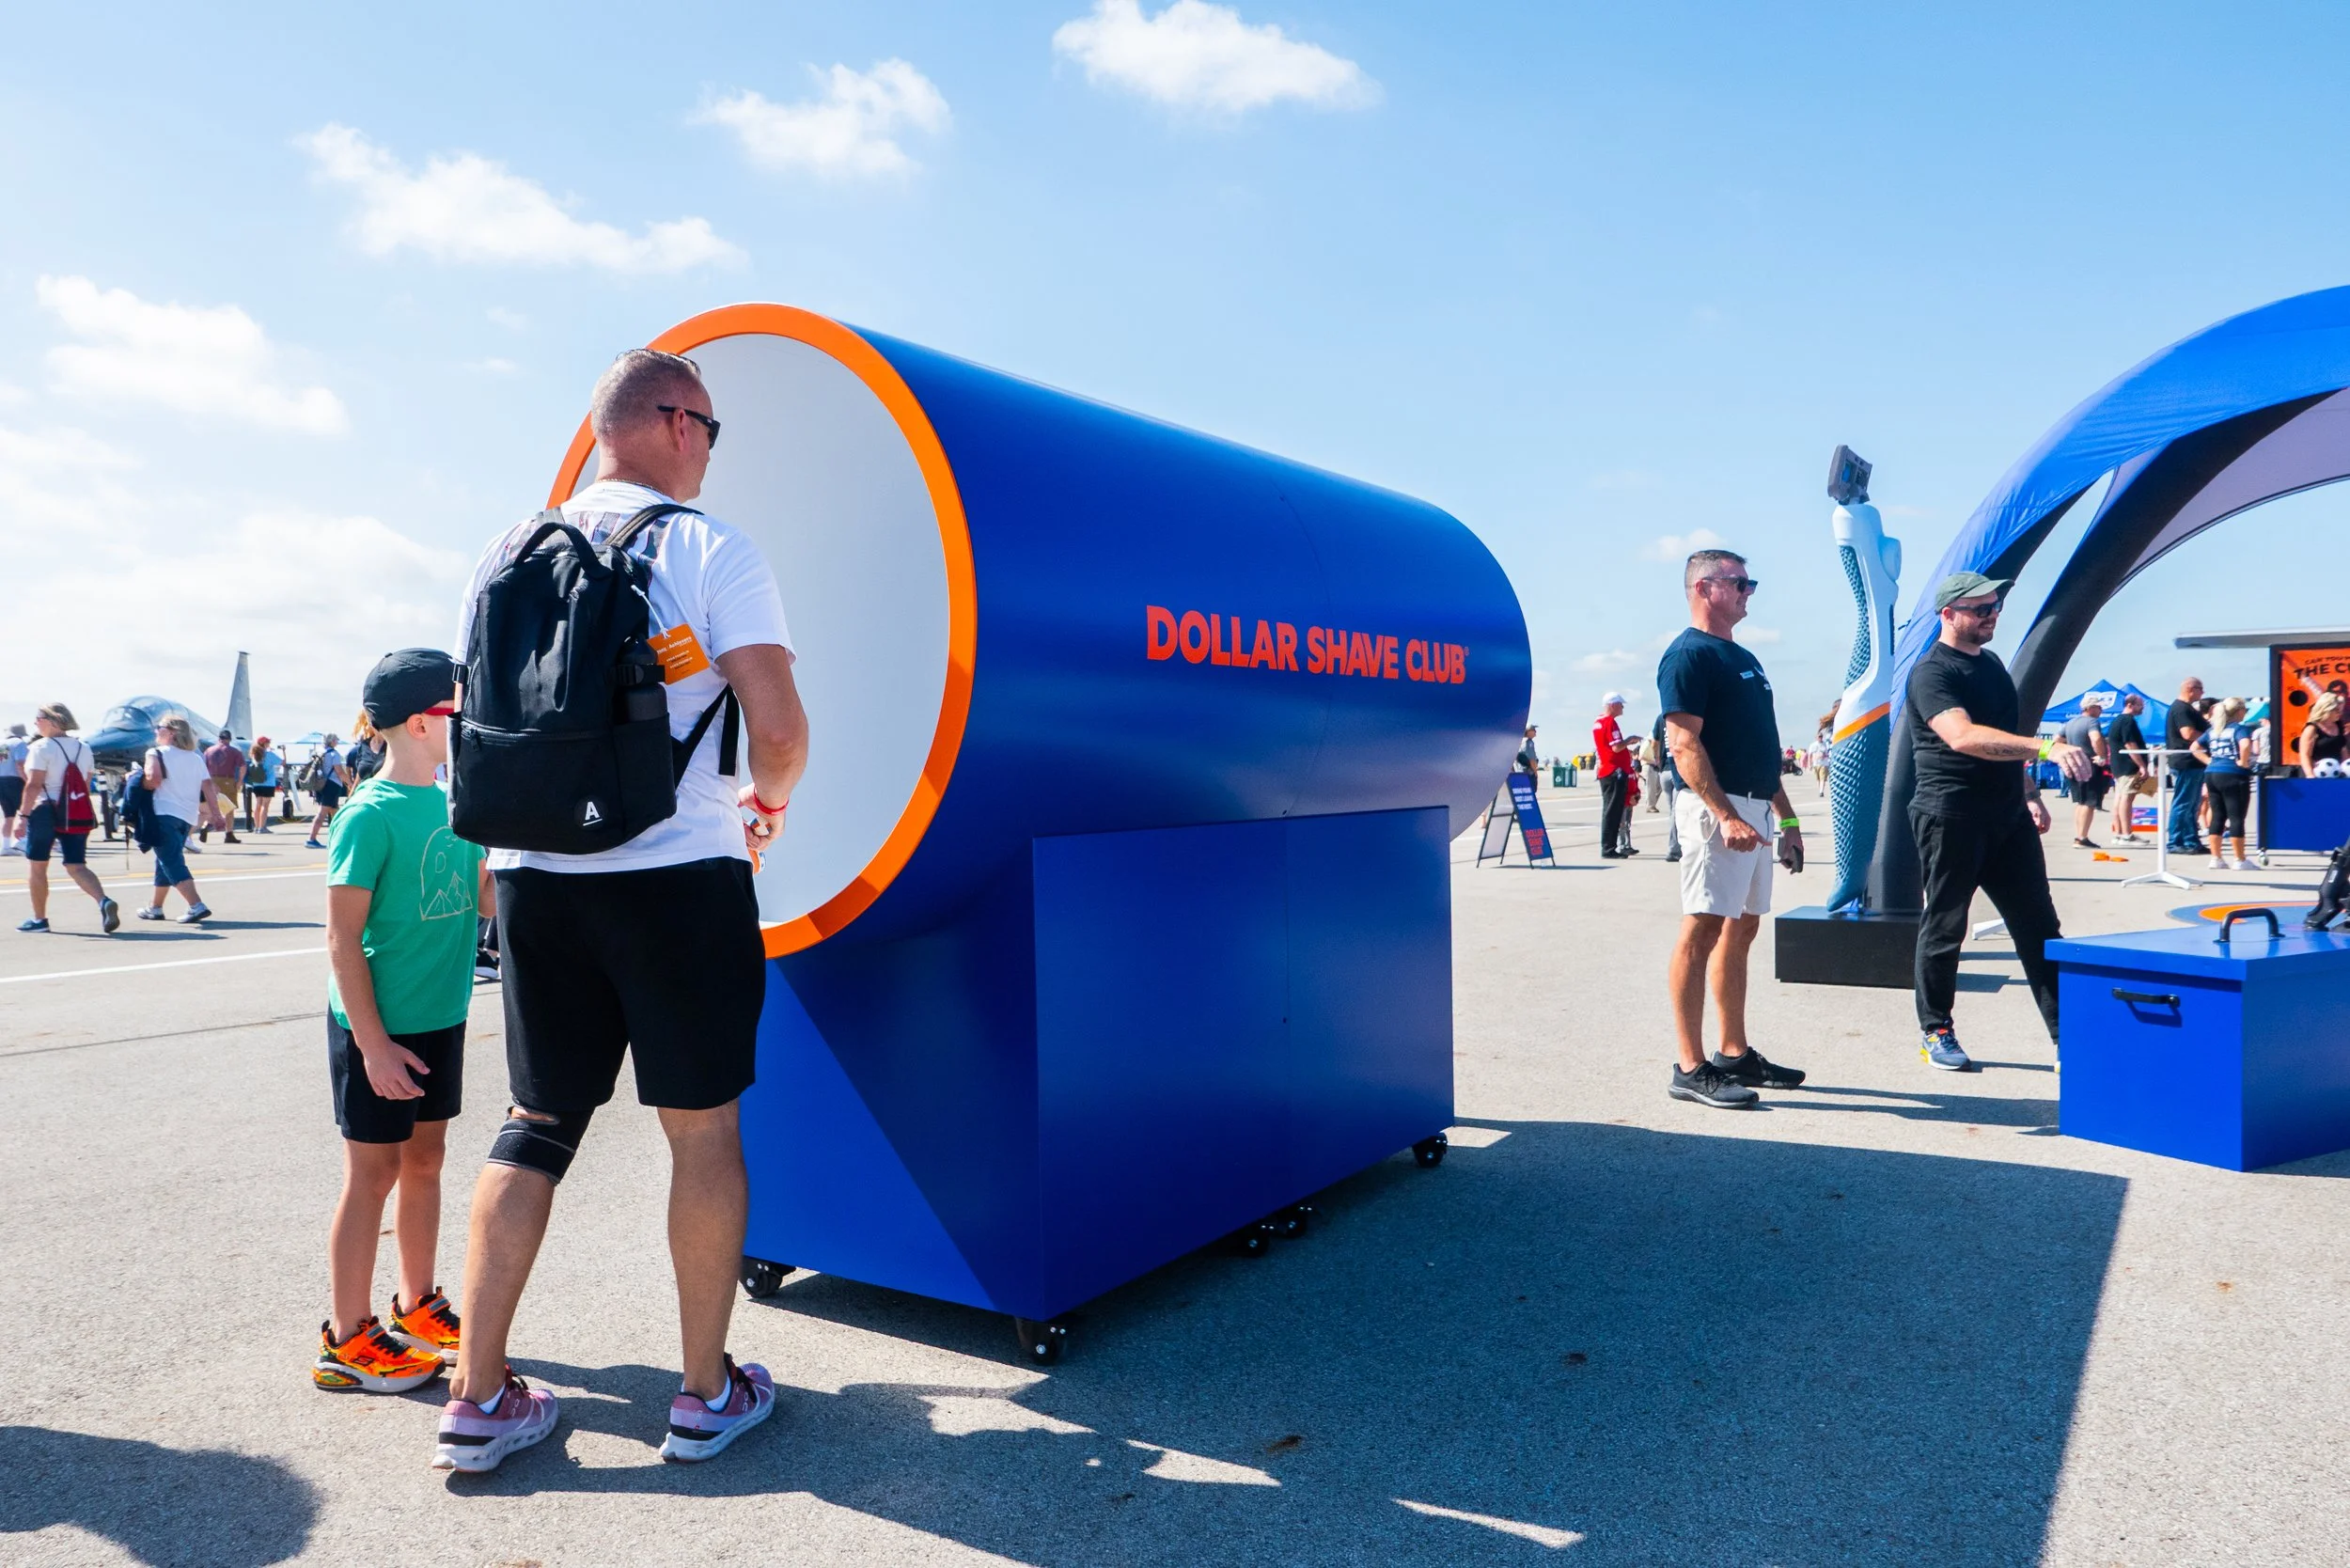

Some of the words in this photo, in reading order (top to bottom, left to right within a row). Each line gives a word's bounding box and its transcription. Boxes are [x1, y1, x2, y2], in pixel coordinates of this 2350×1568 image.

[1147, 604, 1299, 672] DOLLAR
[1307, 625, 1400, 680] SHAVE
[2294, 663, 2330, 680] THE
[585, 801, 601, 821] A
